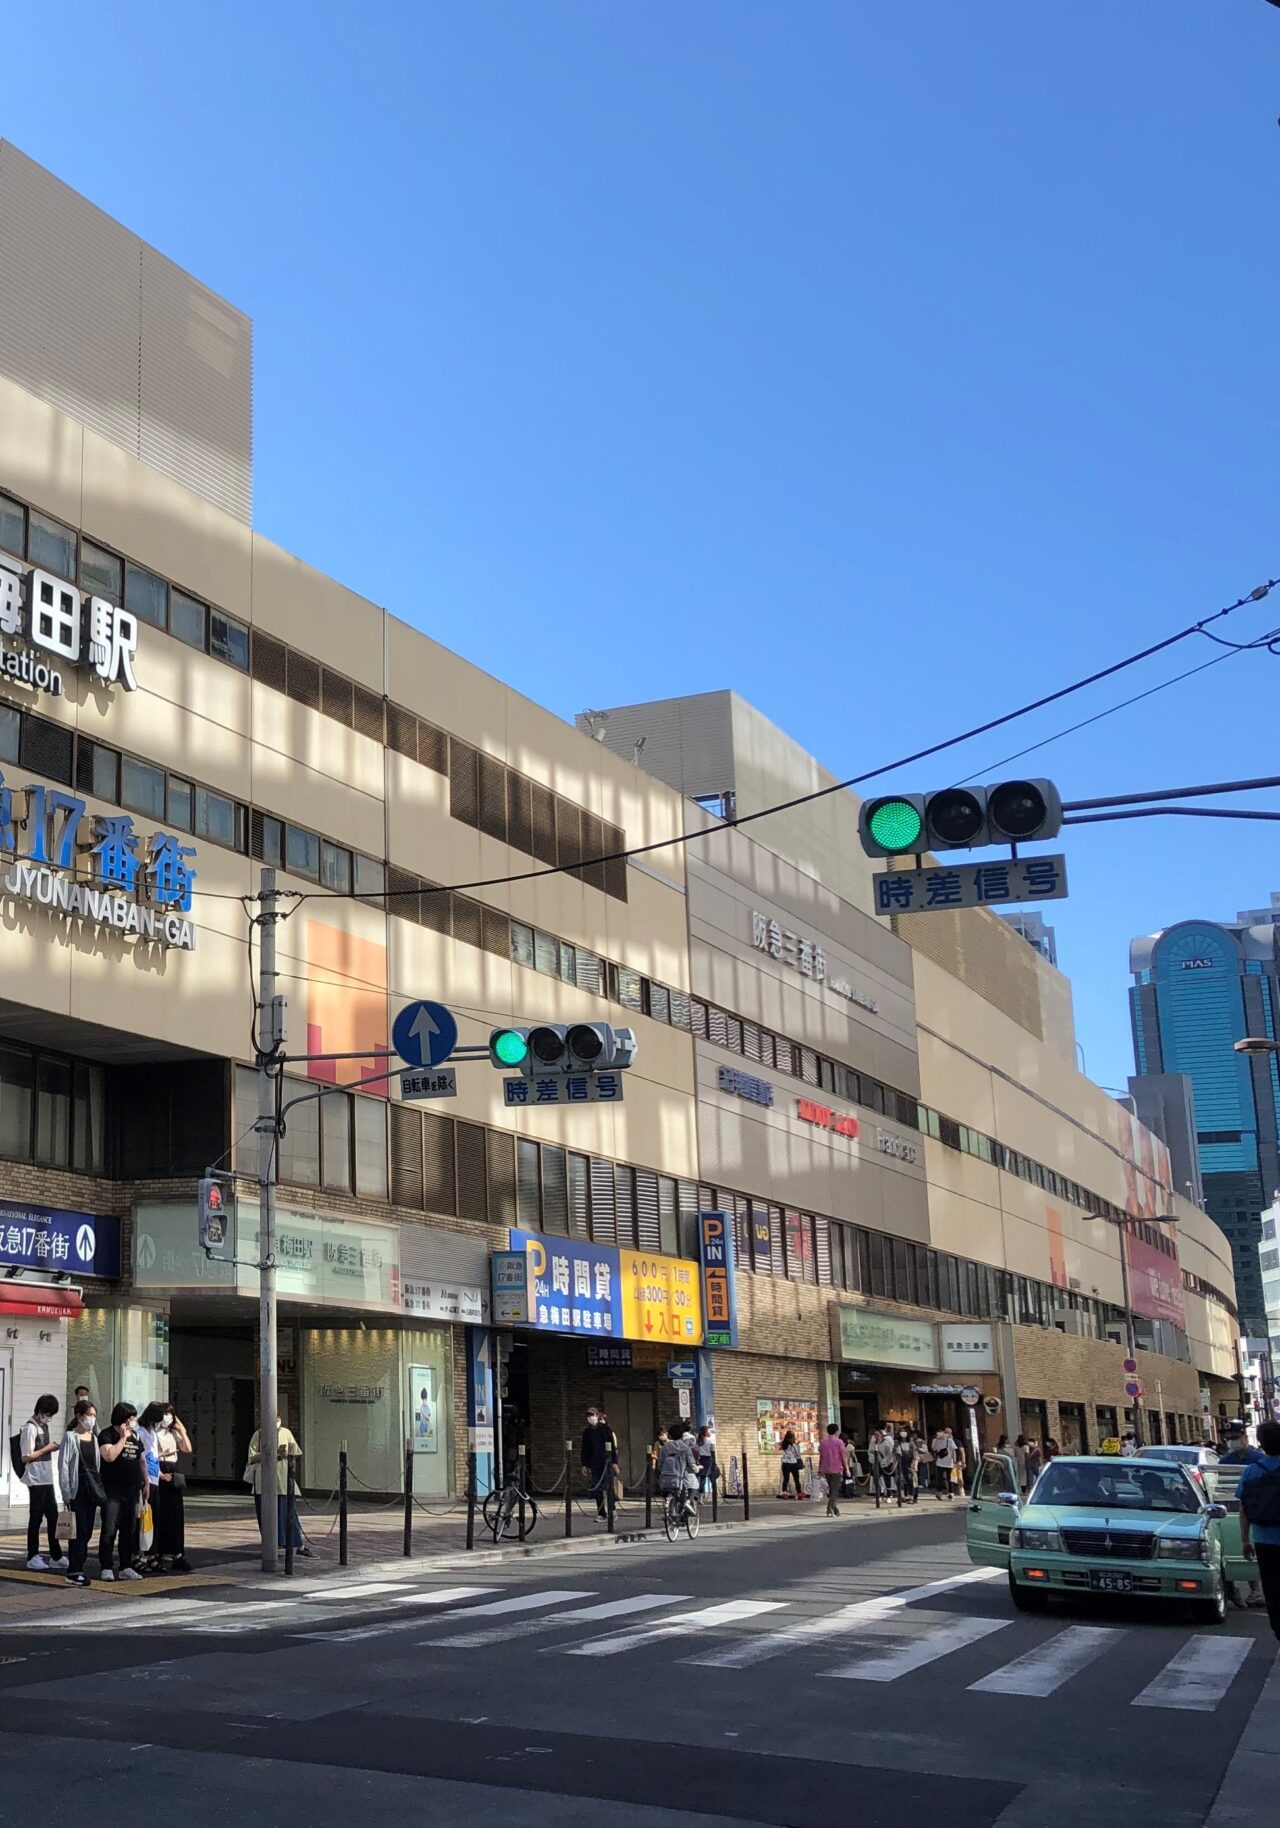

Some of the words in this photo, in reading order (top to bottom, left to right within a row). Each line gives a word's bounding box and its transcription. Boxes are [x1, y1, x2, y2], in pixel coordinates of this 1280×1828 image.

[878, 860, 1061, 909] 時差信号
[1181, 959, 1212, 969] PIAS
[402, 1075, 455, 1095] 自転車を除く
[506, 1075, 619, 1102] 時差信号
[27, 1213, 53, 1225] ELEGANCE
[703, 1219, 723, 1246] P
[707, 1245, 723, 1261] IN
[535, 1278, 550, 1299] 24H
[551, 1255, 612, 1302] 時間貸
[710, 1281, 723, 1317] 時間貸
[37, 1305, 72, 1316] KAMUKURA
[538, 1304, 612, 1331] 急梅田駅駐車場
[658, 1311, 681, 1338] 入口
[707, 1333, 732, 1346] 空車
[1099, 1578, 1131, 1590] 45-85
